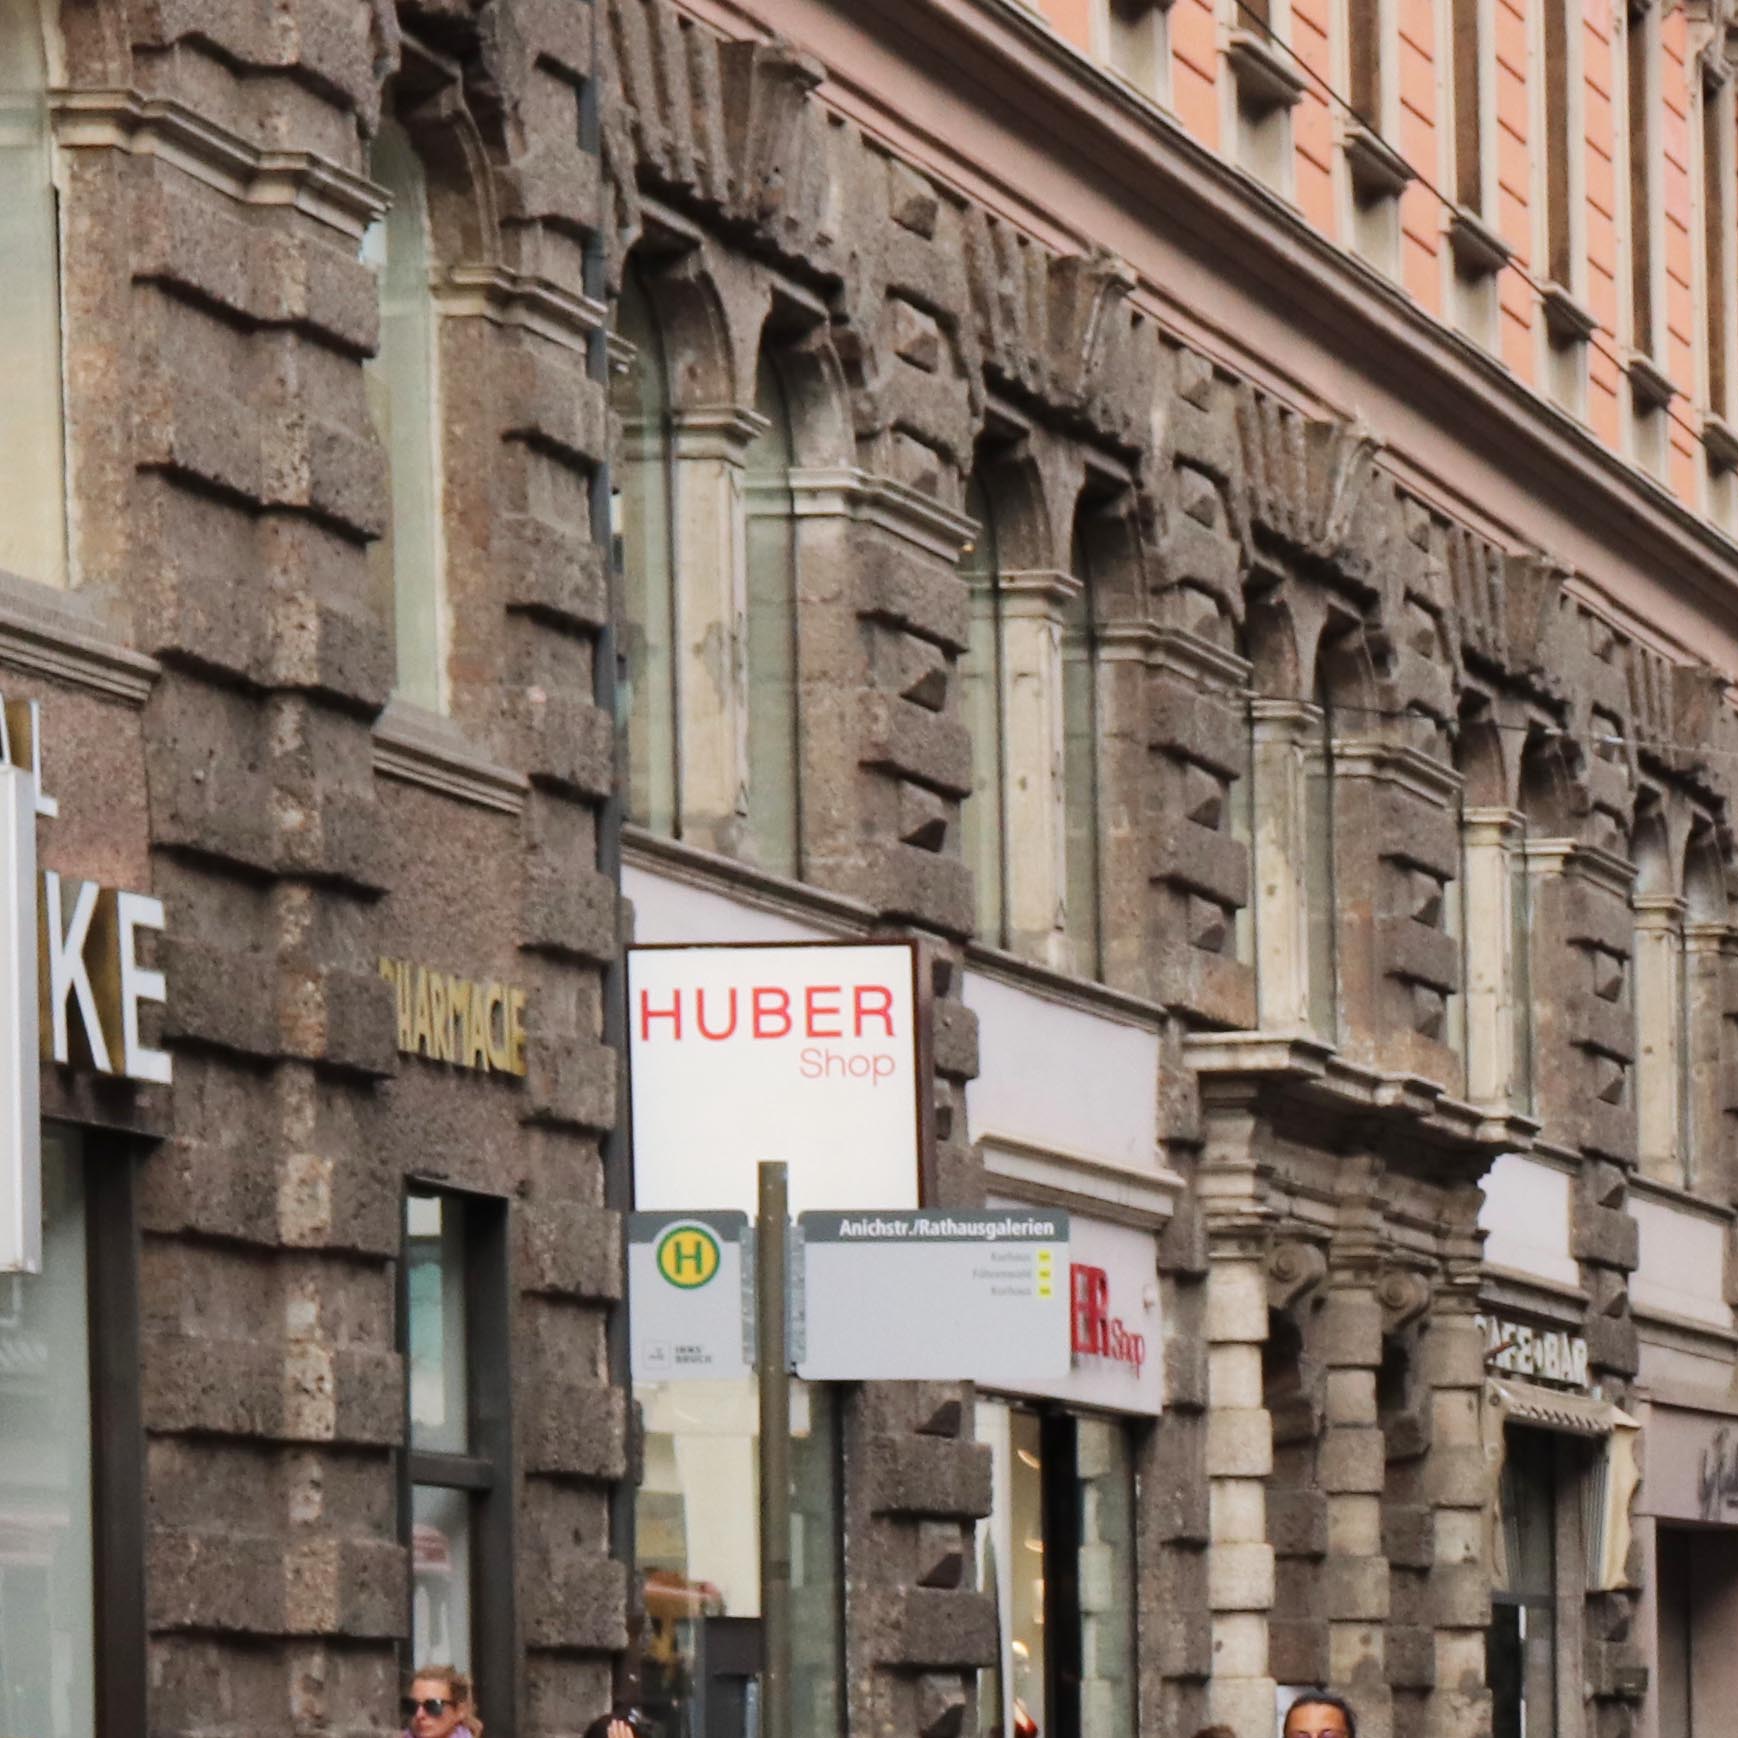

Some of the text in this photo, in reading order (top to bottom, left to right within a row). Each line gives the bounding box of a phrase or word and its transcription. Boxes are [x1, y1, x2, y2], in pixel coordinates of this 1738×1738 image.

[640, 985, 897, 1042] HUBER
[800, 1047, 896, 1087] Shop
[839, 1218, 1055, 1240] Anichstr./Rathausgalerien
[674, 1240, 702, 1275] H
